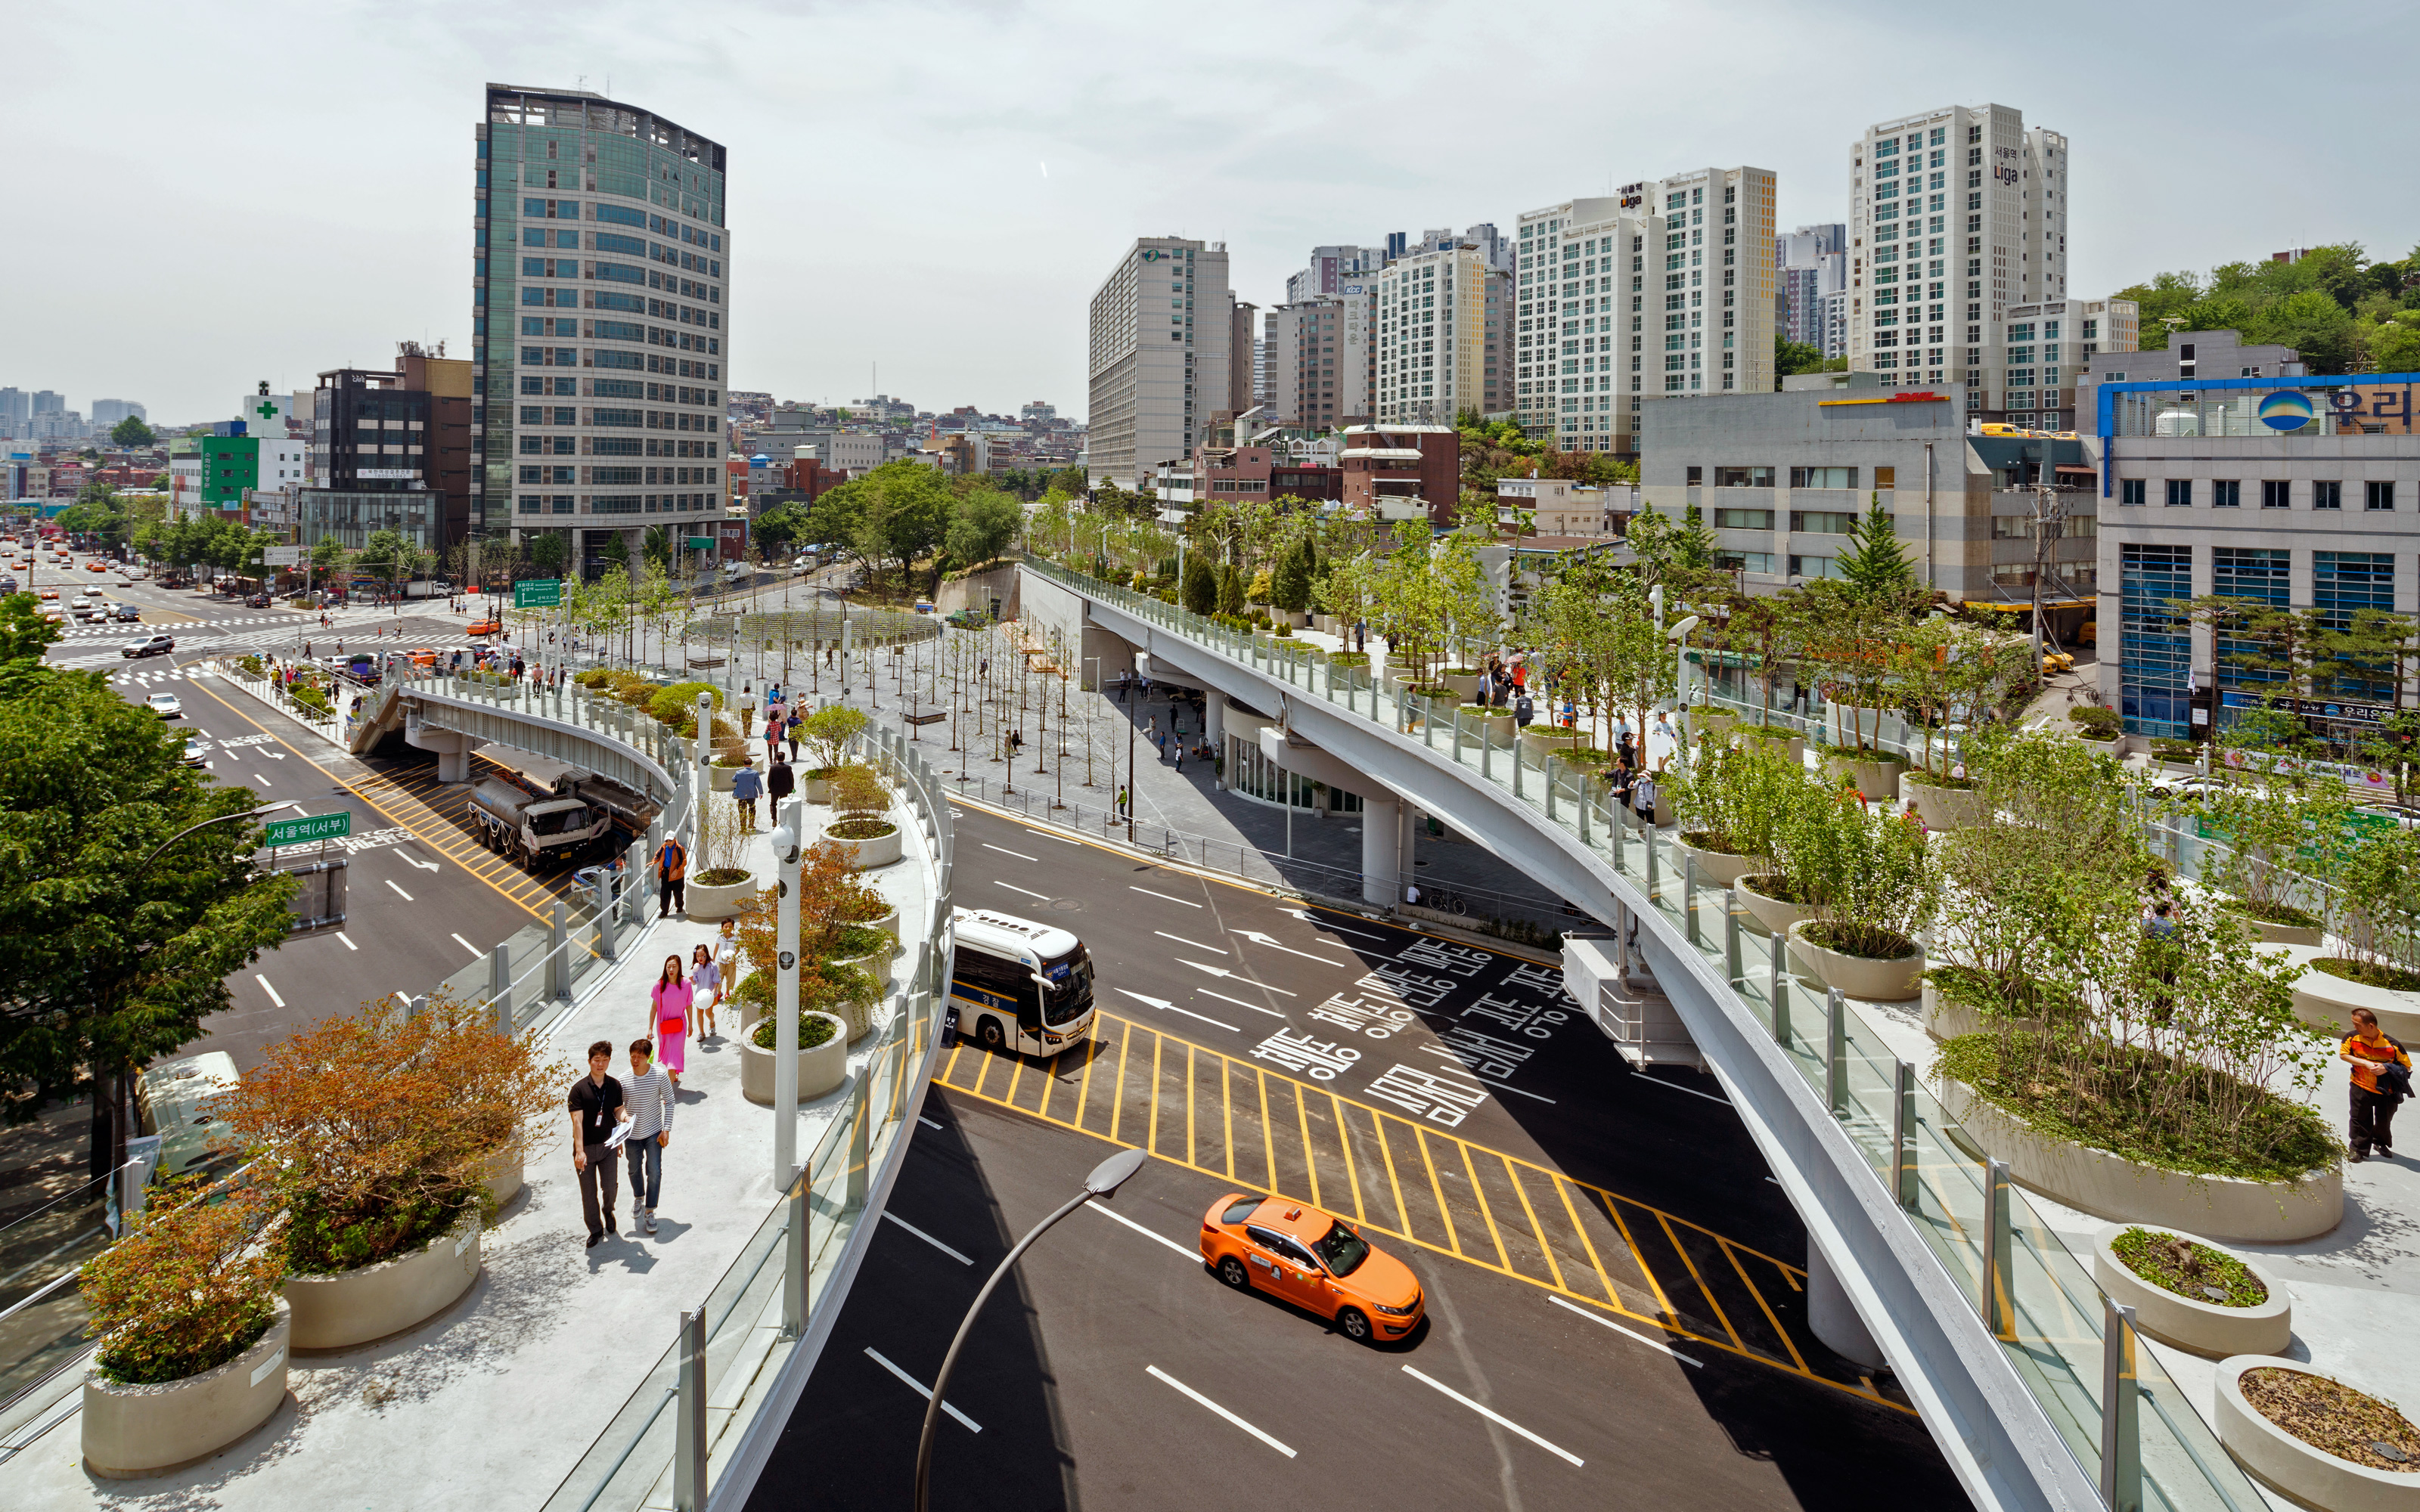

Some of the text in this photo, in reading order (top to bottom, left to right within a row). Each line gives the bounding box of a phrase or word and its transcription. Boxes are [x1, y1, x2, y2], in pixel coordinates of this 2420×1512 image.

[1995, 146, 2017, 161] 서울역
[1994, 162, 2018, 186] Liga
[1621, 182, 1643, 194] 서울역
[1621, 195, 1642, 209] Liga
[1348, 299, 1359, 345] 파크타운
[1894, 392, 1934, 401] DHL
[2279, 700, 2320, 711] 우나라
[2344, 706, 2394, 720] 우리은행
[271, 819, 346, 840] 서울역(서부)
[551, 835, 581, 843] HYUNDAI
[1396, 937, 1493, 977] 만리동
[1354, 963, 1457, 1007] 만리동
[982, 994, 1000, 1009] 경찰
[1307, 992, 1415, 1039] 청파동
[1460, 992, 1569, 1039] 공덕동
[1249, 1027, 1362, 1080] 청파동
[1419, 1027, 1535, 1079] 삼거리
[1364, 1063, 1490, 1127] 삼거리
